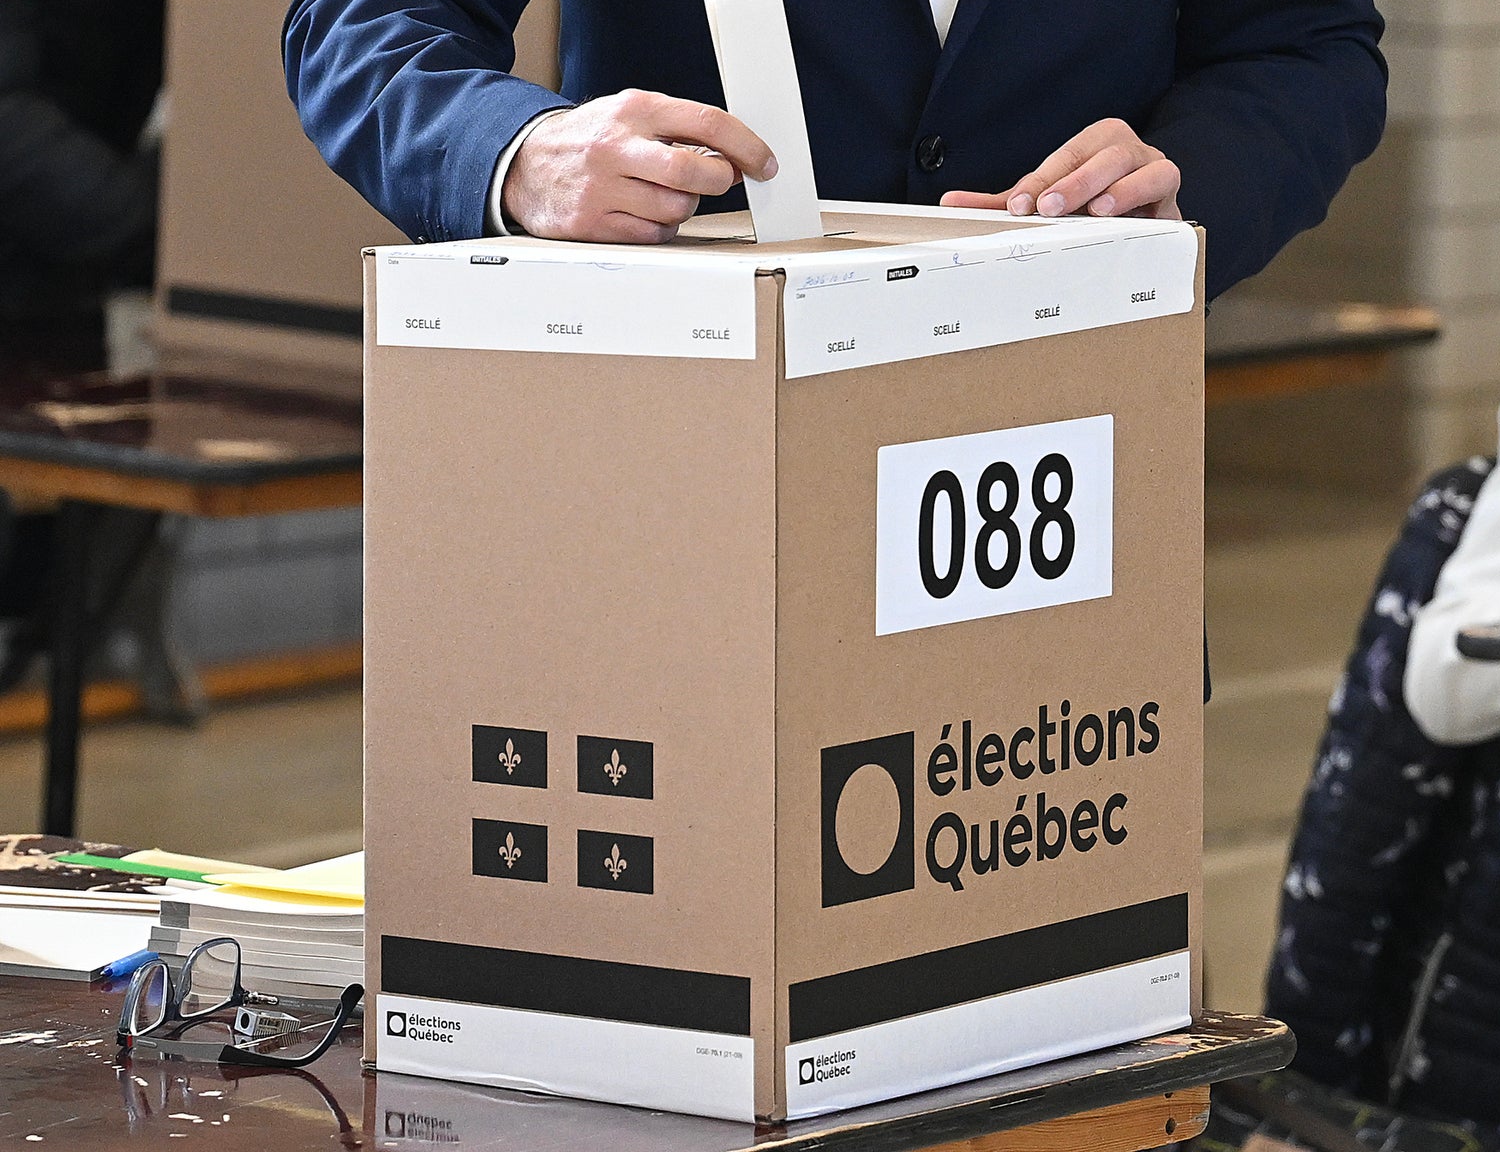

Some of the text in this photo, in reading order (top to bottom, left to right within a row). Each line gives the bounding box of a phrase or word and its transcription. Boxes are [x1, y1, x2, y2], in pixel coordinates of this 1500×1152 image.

[471, 255, 503, 264] INITIALES
[1130, 287, 1156, 304] SCELLÉ
[1034, 304, 1061, 320] SCELLÉ
[405, 317, 441, 330] SCELLÉ
[546, 322, 583, 335] SCELLÉ
[933, 320, 961, 336] SCELLÉ
[692, 327, 731, 340] SCELLÉ
[827, 337, 856, 354] SCELLÉ
[918, 453, 1075, 599] 088
[927, 699, 1161, 797] élections
[925, 792, 1128, 892] Québec
[408, 1013, 462, 1032] élections
[408, 1028, 454, 1044] Québec
[816, 1049, 856, 1067] élections
[816, 1064, 851, 1083] Québec
